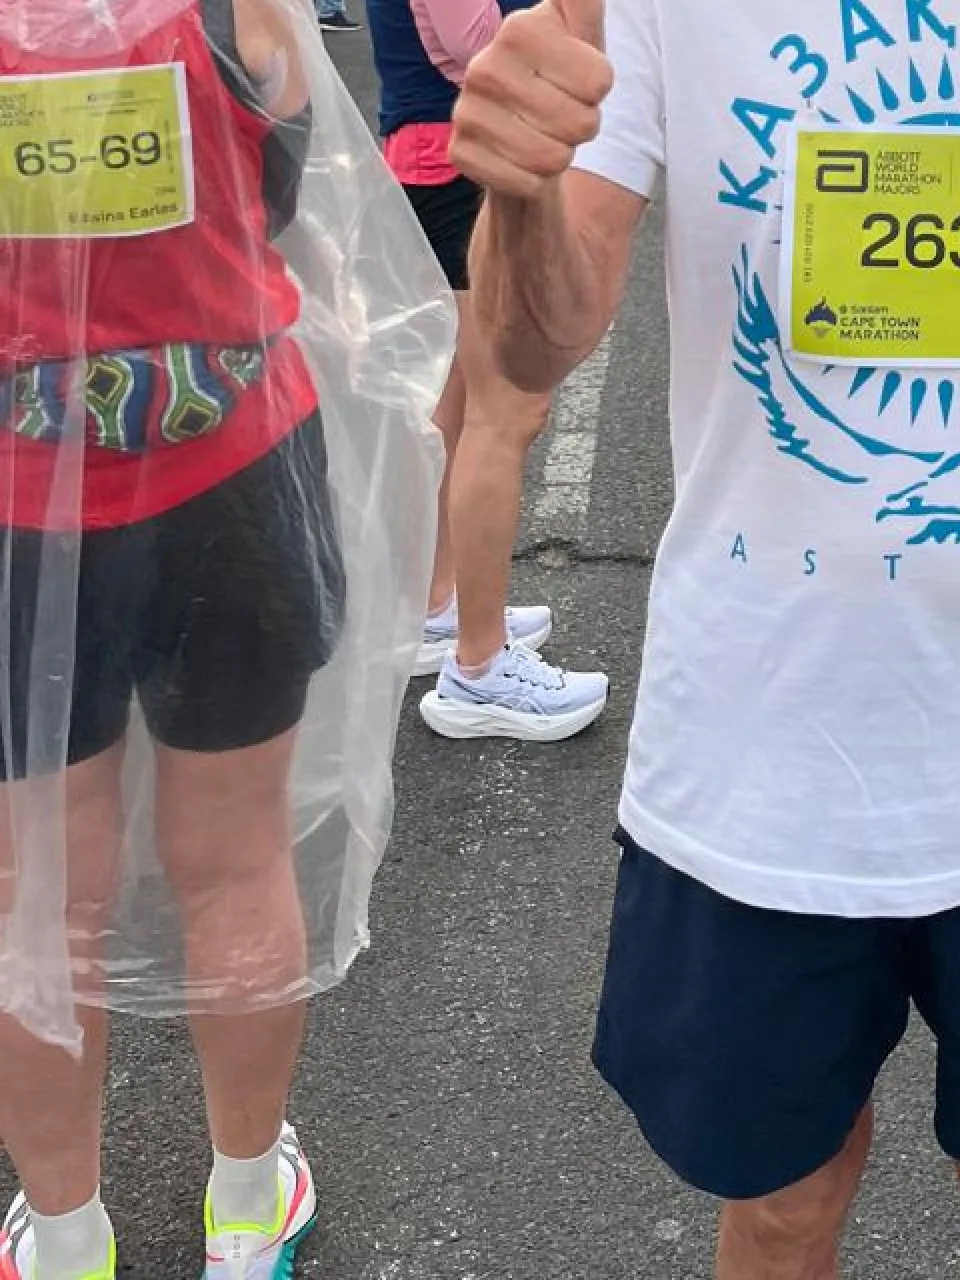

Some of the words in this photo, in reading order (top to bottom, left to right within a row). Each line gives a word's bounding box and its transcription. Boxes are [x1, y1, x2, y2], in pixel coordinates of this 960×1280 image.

[14, 131, 161, 177] 65-69
[876, 151, 921, 162] ABBOTT
[876, 163, 919, 172] WORLD
[874, 173, 942, 184] MARATHON
[874, 185, 921, 195] MAJORS
[840, 318, 875, 327] CAPE
[881, 318, 921, 328] TOWN
[839, 329, 919, 340] MARATHON
